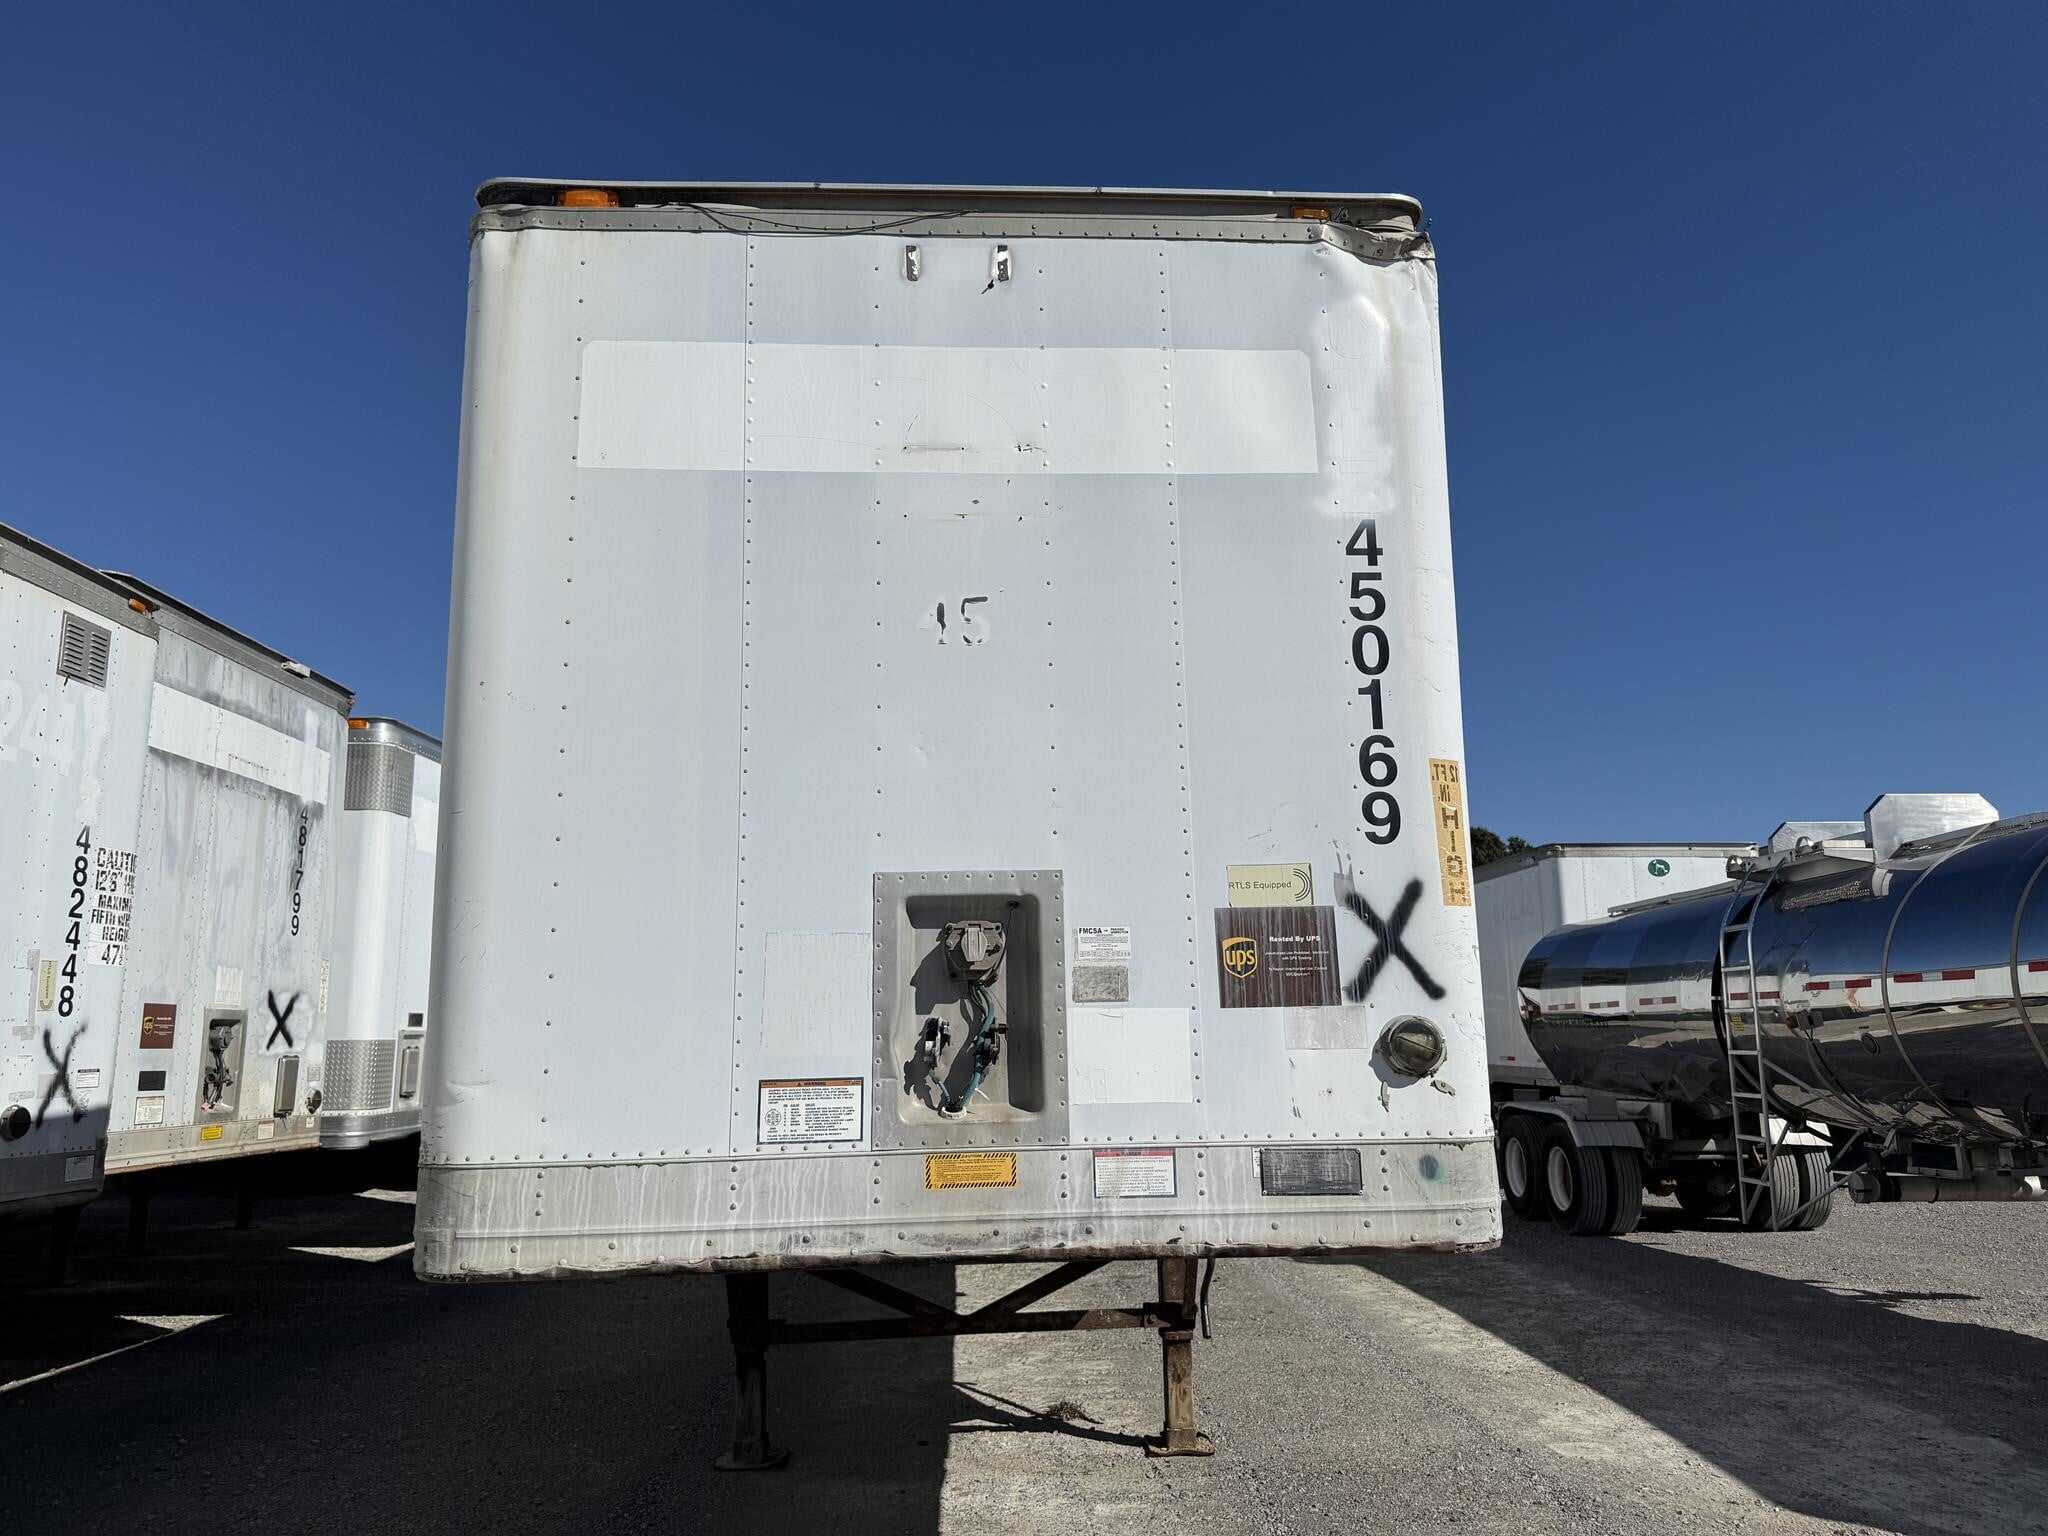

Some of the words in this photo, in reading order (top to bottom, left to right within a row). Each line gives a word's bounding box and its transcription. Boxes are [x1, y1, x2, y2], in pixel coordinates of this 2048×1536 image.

[1345, 519, 1401, 845] 450169
[291, 804, 309, 937] 481799
[1228, 881, 1251, 890] RTLS
[1253, 880, 1292, 891] Equipped
[58, 825, 91, 1018] 482448
[1226, 949, 1255, 972] ups
[1306, 934, 1321, 942] UPS
